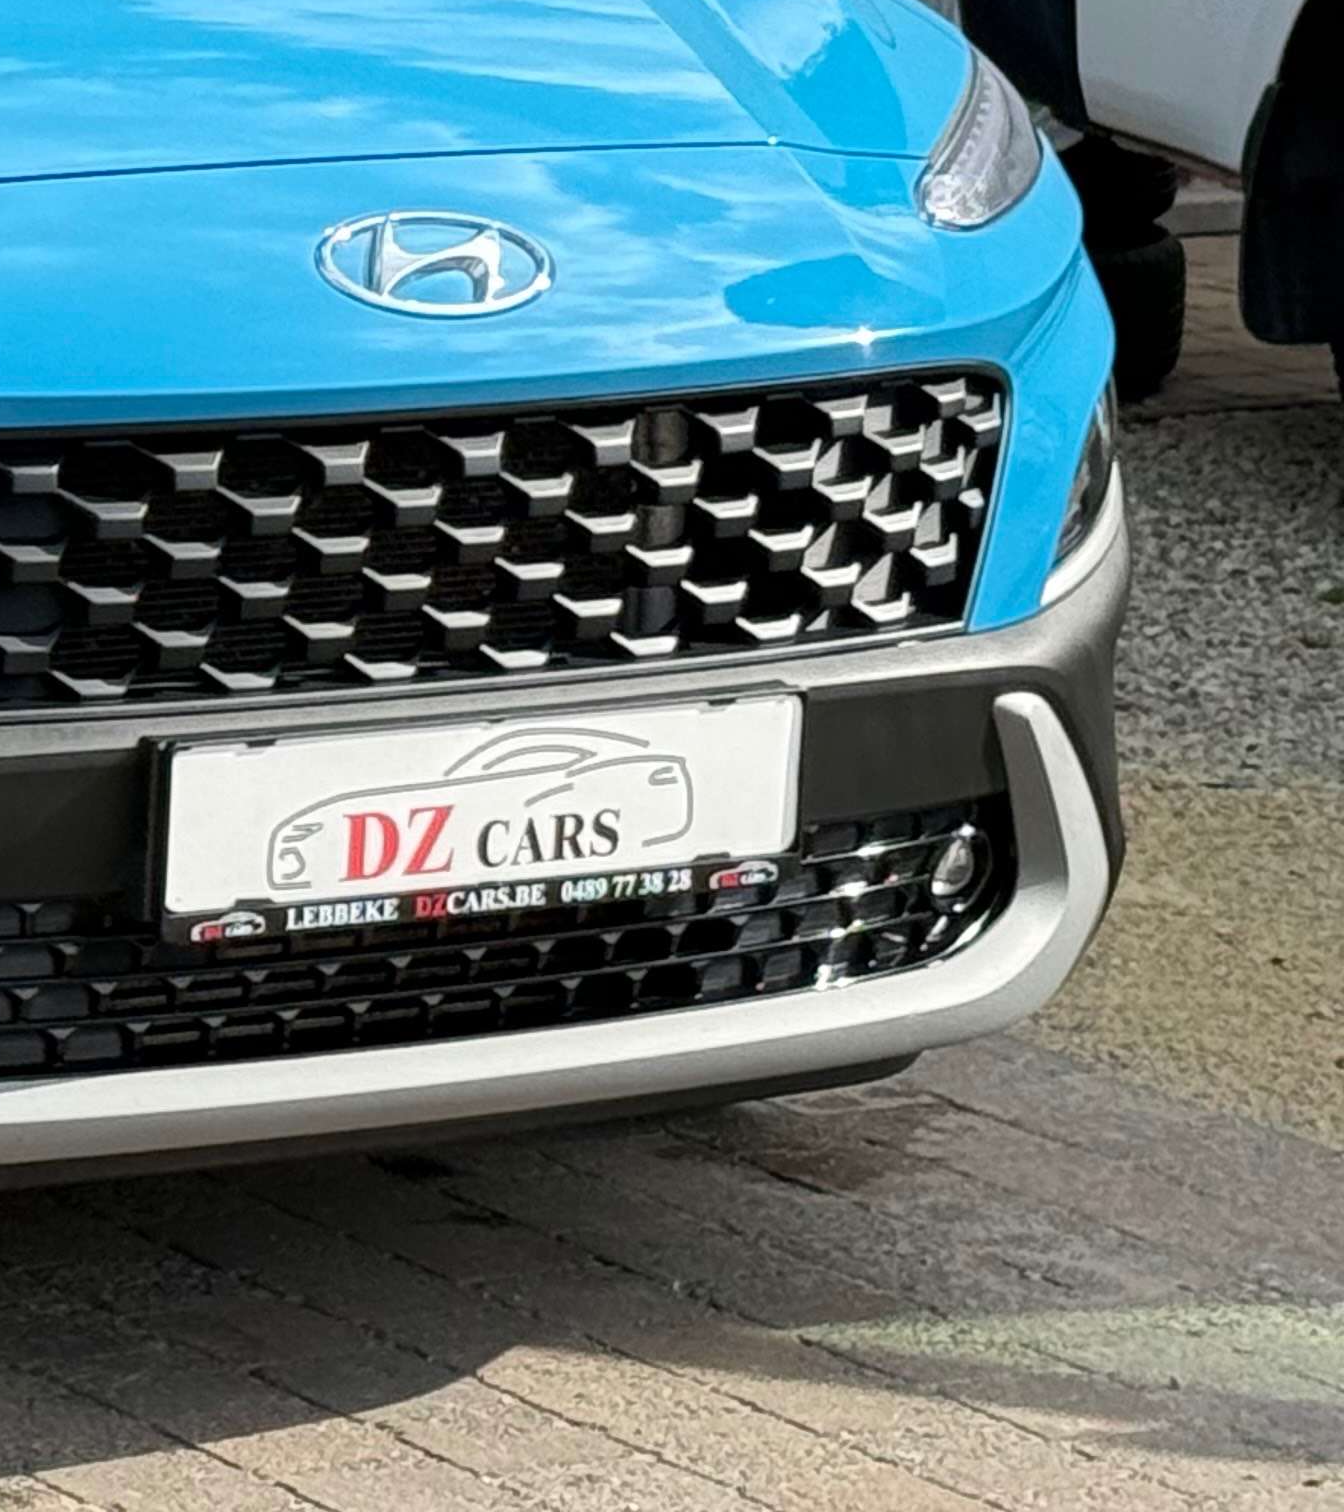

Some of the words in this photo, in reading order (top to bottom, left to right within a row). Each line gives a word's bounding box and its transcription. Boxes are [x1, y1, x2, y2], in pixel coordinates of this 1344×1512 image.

[339, 804, 455, 882] DZ
[477, 808, 621, 868] CARS
[286, 897, 400, 931] LEBBEKE
[416, 883, 547, 918] DZCARS.BE
[561, 877, 608, 902] 0489
[613, 873, 637, 898] 77
[638, 871, 665, 895] 38
[668, 868, 692, 891] 28
